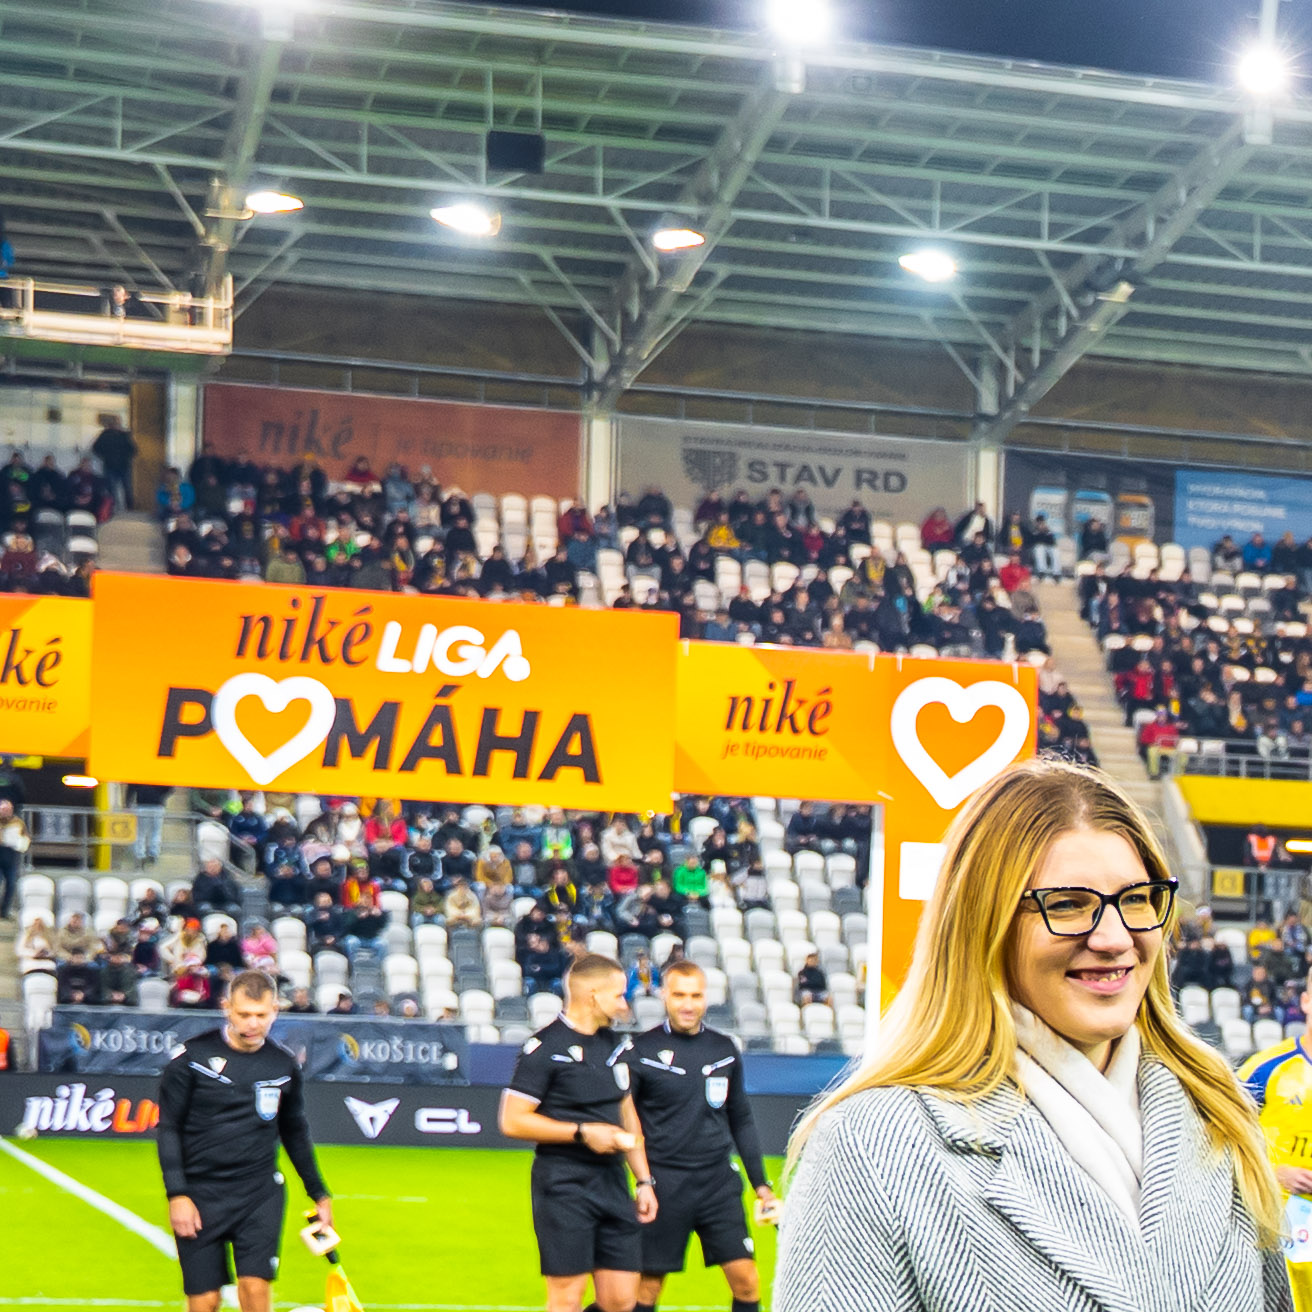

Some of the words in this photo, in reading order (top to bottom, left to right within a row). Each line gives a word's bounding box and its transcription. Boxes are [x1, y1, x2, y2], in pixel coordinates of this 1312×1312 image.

[747, 459, 843, 488] STAV
[855, 468, 908, 493] RD
[234, 595, 375, 667] niké
[377, 620, 531, 682] LIGA
[157, 673, 603, 785] PMÁHA
[724, 679, 834, 737] niké
[720, 739, 741, 761] je
[744, 739, 829, 761] tipovanie
[22, 1082, 116, 1132] niké
